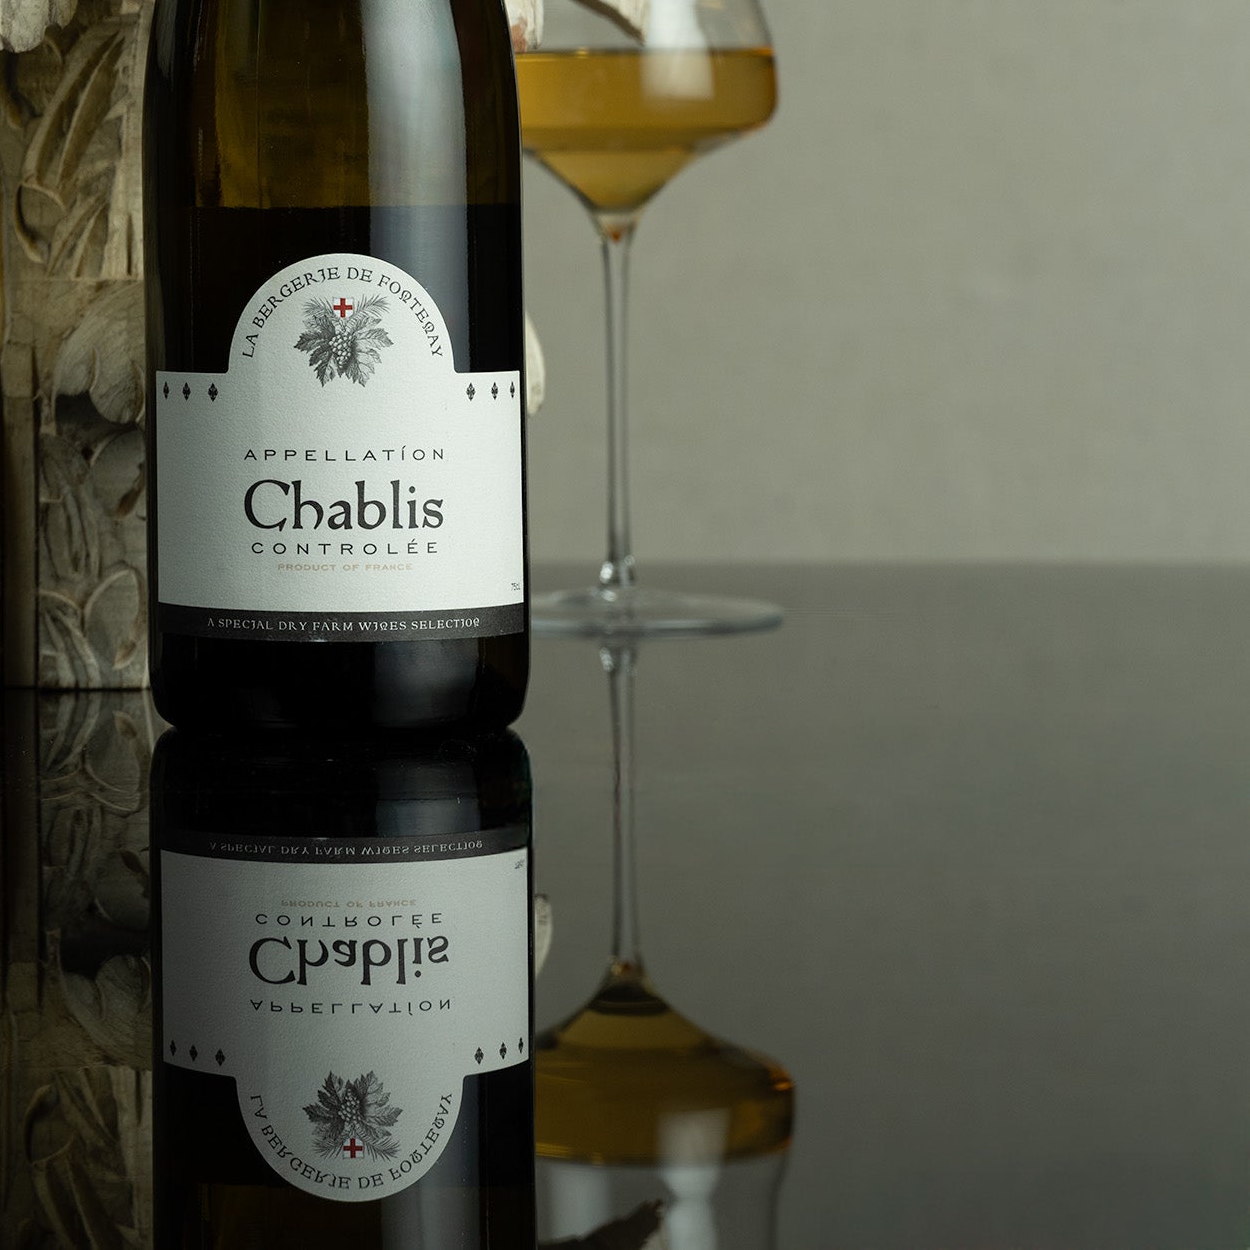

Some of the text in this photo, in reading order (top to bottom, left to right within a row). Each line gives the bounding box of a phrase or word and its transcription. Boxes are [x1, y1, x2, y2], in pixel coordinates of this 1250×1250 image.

[242, 334, 259, 358] LA
[347, 267, 373, 283] DE
[244, 479, 444, 532] Chablis
[251, 539, 438, 555] CONTROLÉE
[277, 563, 413, 571] PRODUCT OF FRANCE
[207, 618, 215, 628] A
[278, 621, 308, 631] DRY
[312, 621, 354, 632] FARM
